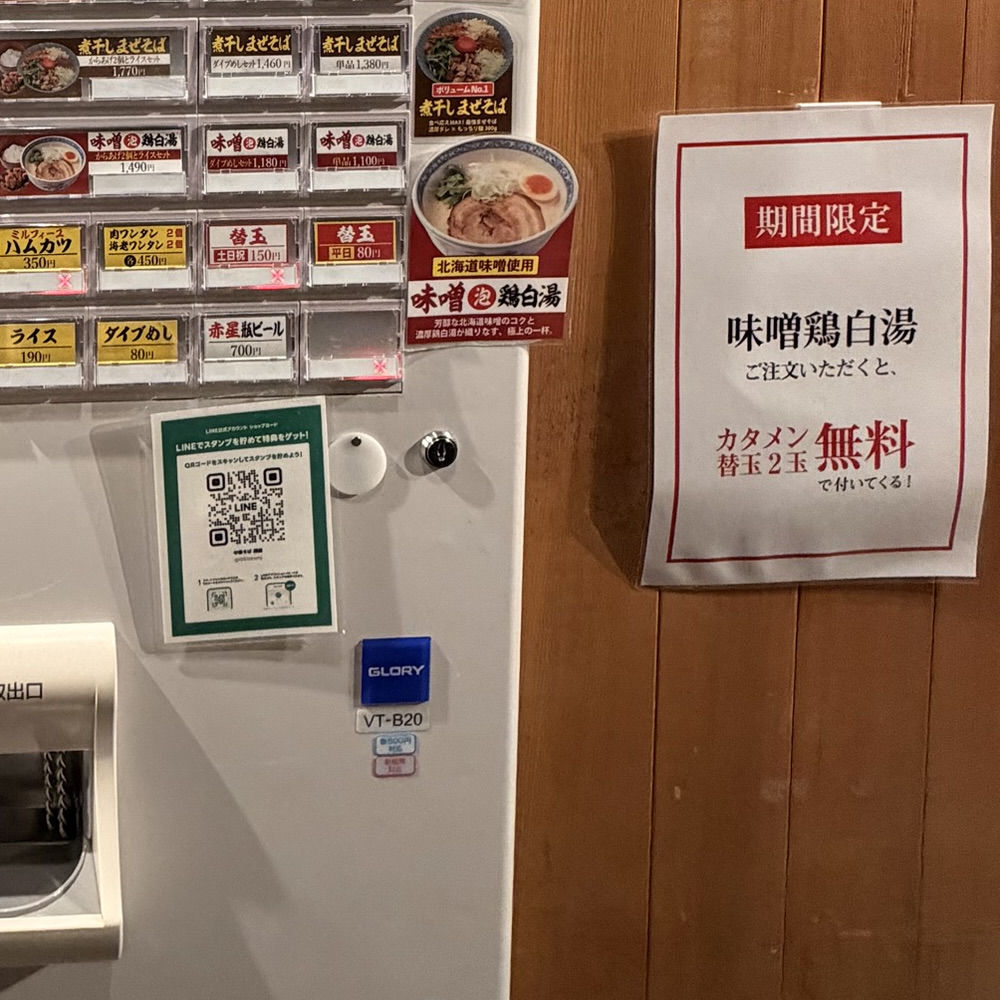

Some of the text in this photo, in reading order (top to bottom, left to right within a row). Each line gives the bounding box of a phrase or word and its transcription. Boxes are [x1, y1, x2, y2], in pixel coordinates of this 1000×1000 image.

[78, 36, 168, 55] 煮干しまぜそば
[211, 34, 292, 54] 煮干しまぜそば
[321, 35, 401, 54] 煮干しまぜそば
[257, 57, 291, 70] 1,460円
[355, 58, 389, 70] 1,380円
[112, 66, 147, 77] 1,770円
[435, 84, 489, 95] ボリュームNo.1
[418, 97, 508, 118] 煮干しまぜそば
[120, 161, 156, 173] 1,490円
[252, 156, 287, 169] 1,180円
[754, 201, 891, 239] 期間限定
[109, 229, 160, 240] 肉ワンタン
[229, 226, 268, 246] 替玉
[336, 224, 376, 244] 替玉
[4, 237, 73, 255] ハムカツ
[109, 239, 164, 251] 海老ワンタン
[330, 246, 382, 259] 平日 80円
[23, 256, 56, 270] 350円
[216, 249, 282, 262] 土日祝 150円
[436, 258, 534, 274] 北海道味噌使用
[9, 328, 58, 345] ライス
[103, 325, 173, 344] ダイブめし
[726, 306, 919, 353] 味噌鶏白湯
[20, 350, 51, 364] 190円
[130, 348, 155, 361] 80円
[230, 344, 262, 357] 700円
[744, 357, 897, 382] ご注文いただくと、
[716, 418, 915, 472] カタメン 無料
[716, 450, 808, 477] 替玉2玉
[234, 502, 257, 514] LINE
[367, 664, 426, 678] GLORY
[363, 712, 423, 728] VT-B20
